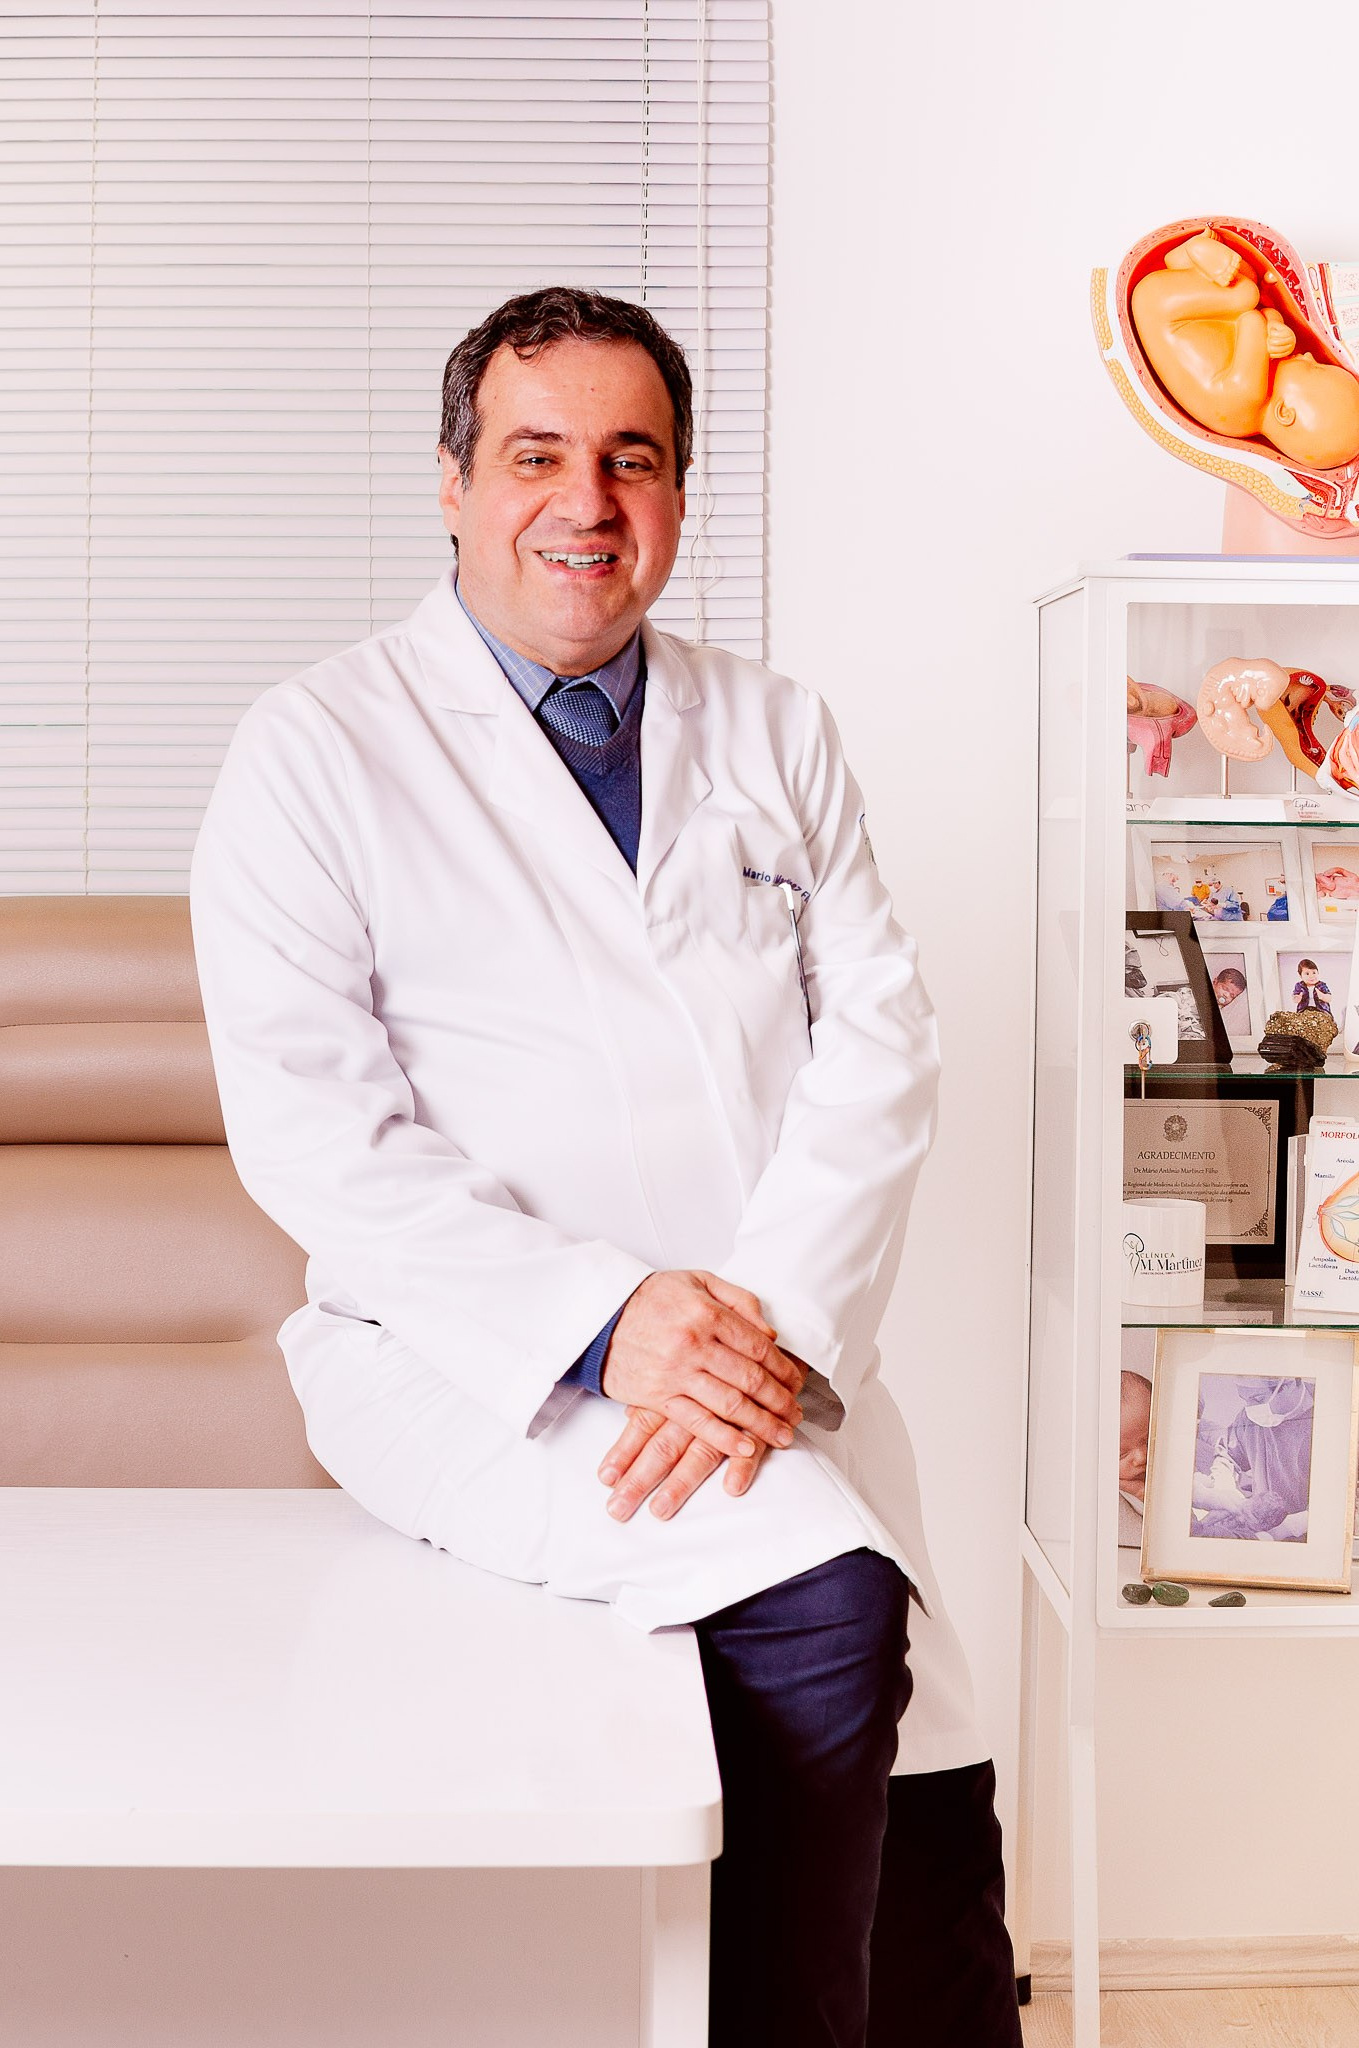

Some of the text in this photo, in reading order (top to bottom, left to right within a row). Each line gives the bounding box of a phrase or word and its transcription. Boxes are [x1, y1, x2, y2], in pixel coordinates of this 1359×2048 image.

[742, 866, 771, 882] Mario
[1320, 1131, 1359, 1140] MORFOL
[1137, 1151, 1216, 1160] AGRADECIMENTO
[1140, 1256, 1202, 1271] M. Martinez
